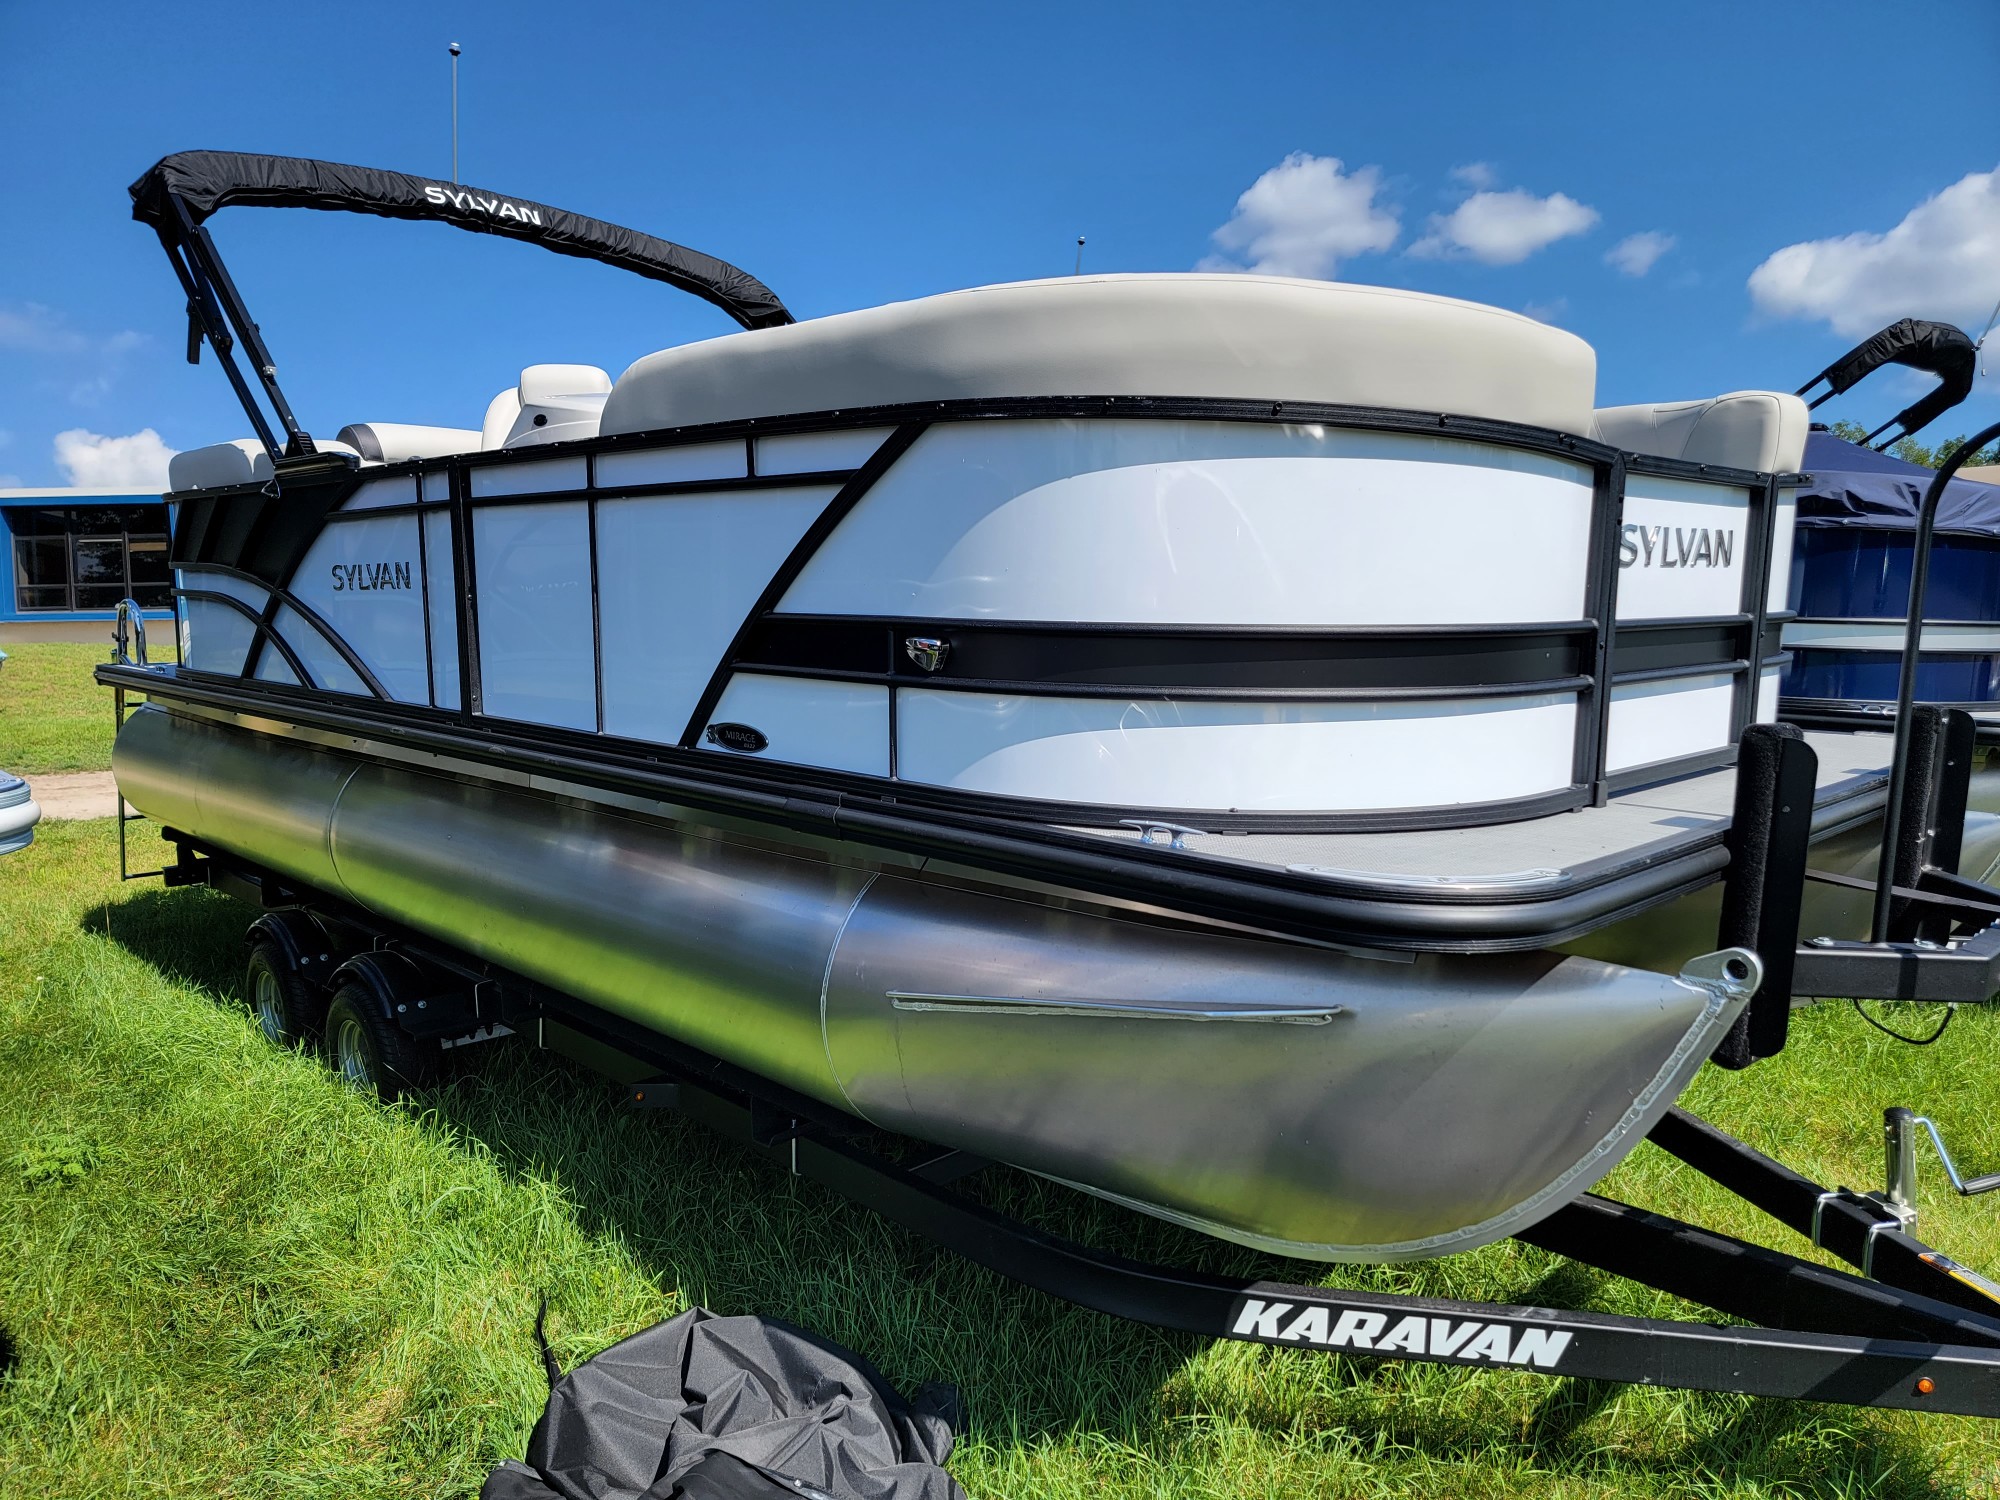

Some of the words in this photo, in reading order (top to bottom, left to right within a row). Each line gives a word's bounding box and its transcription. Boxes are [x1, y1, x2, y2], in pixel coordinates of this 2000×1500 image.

[425, 186, 541, 225] SYLVAN
[1619, 524, 1733, 568] SYLVAN
[332, 562, 411, 591] SYLVAN
[725, 730, 756, 743] MIRAGE
[1232, 1299, 1574, 1367] KARAVAN
